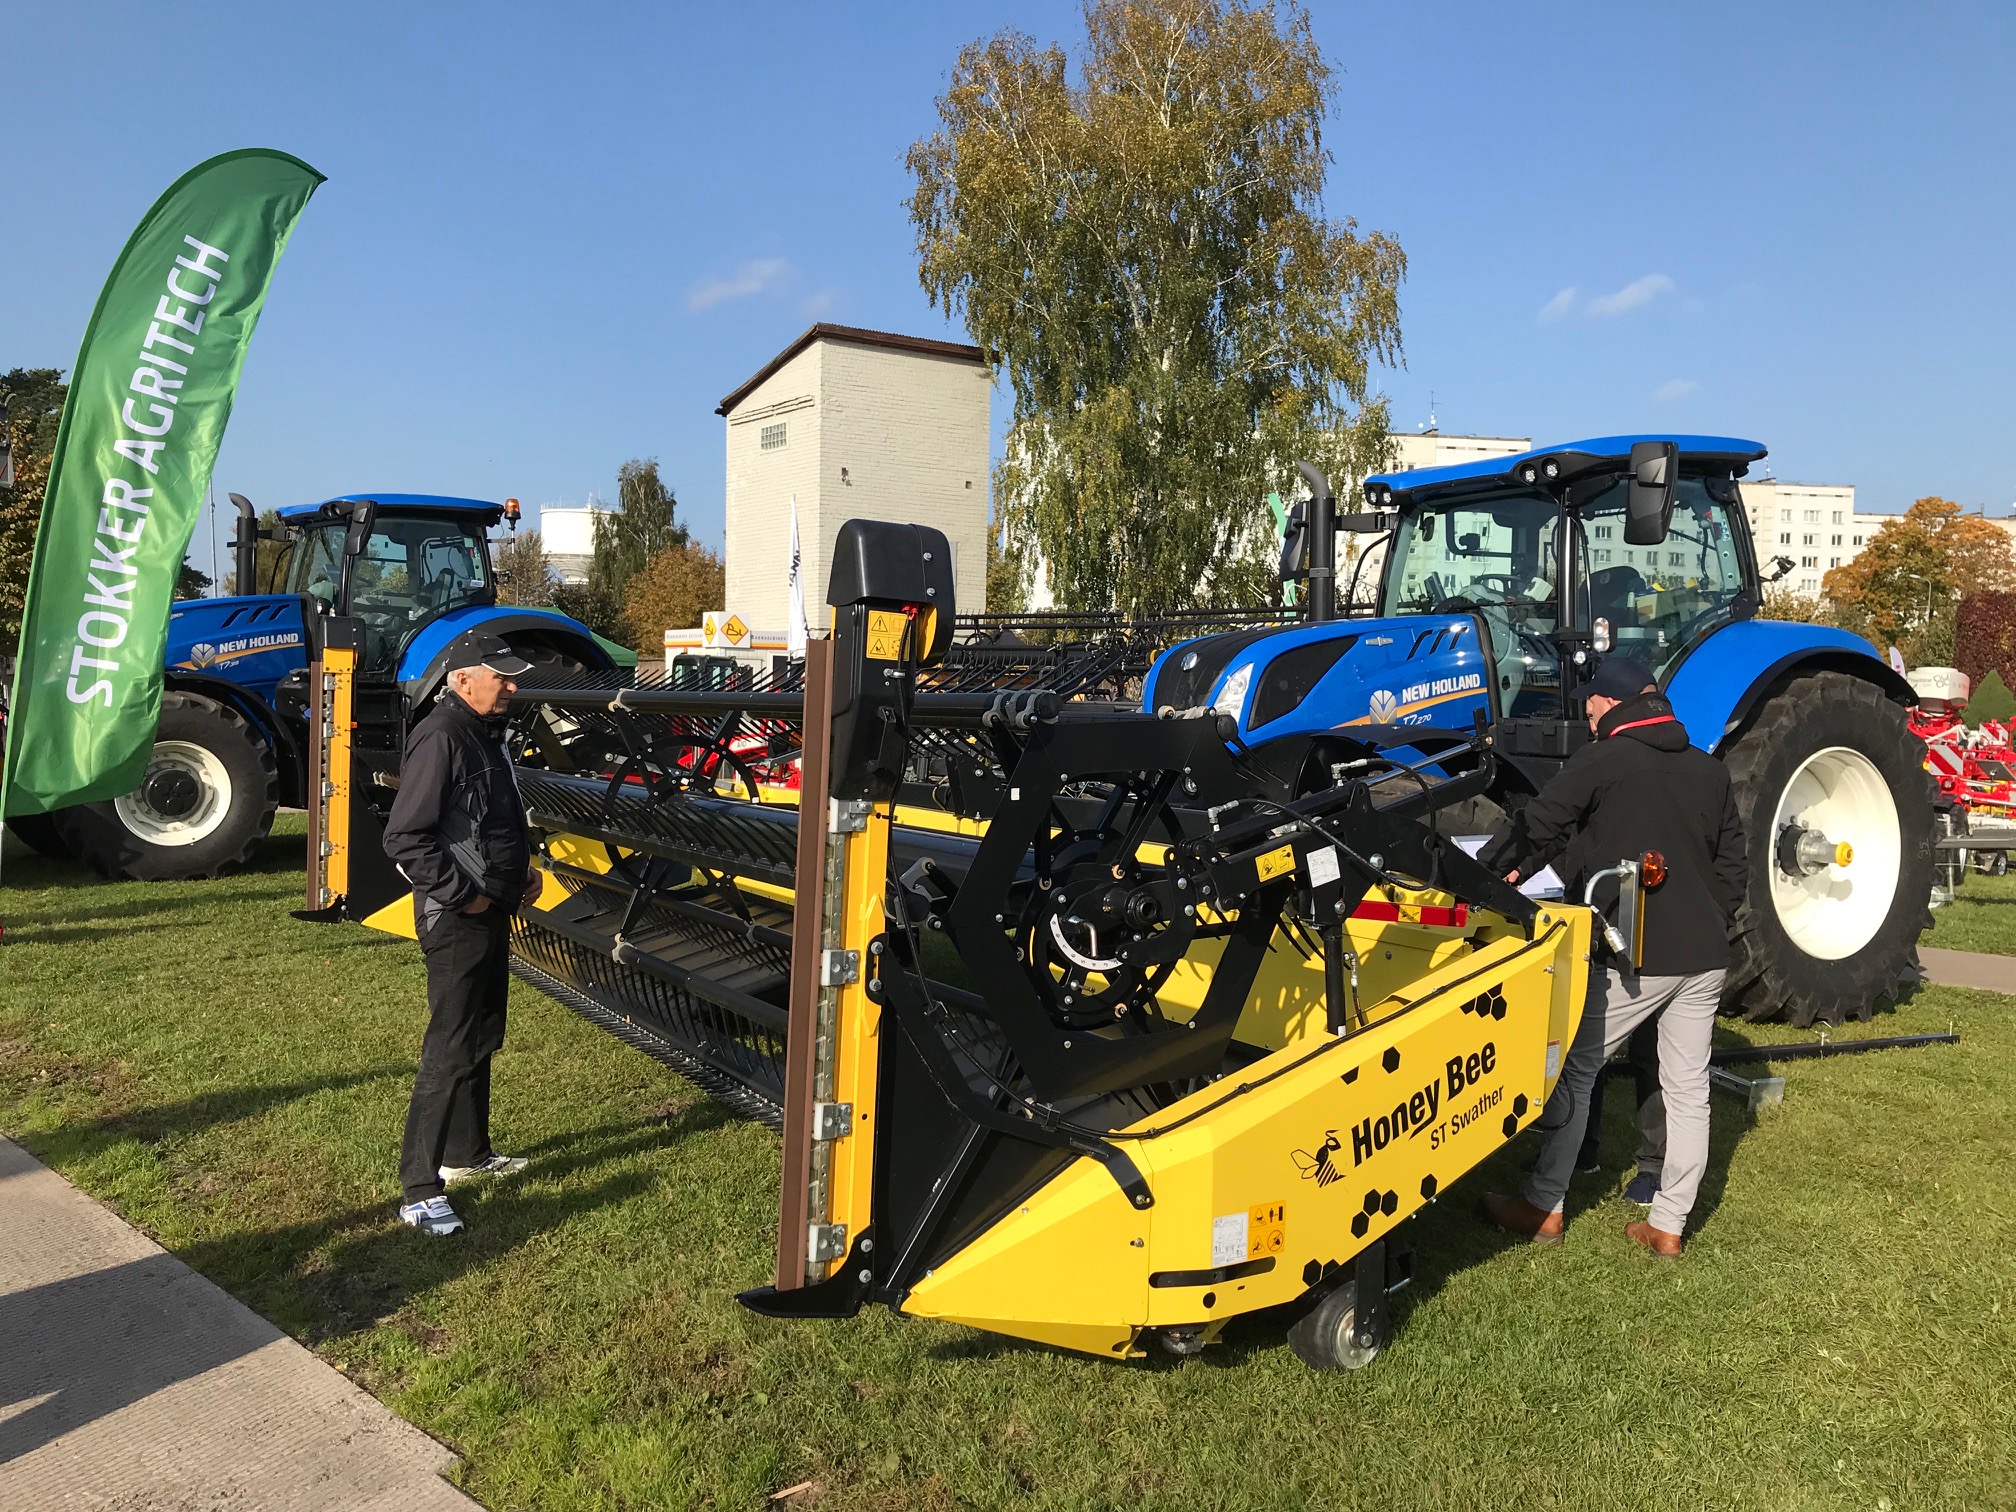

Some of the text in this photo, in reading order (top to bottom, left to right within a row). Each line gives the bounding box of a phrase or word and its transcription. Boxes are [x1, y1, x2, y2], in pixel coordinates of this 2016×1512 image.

[66, 234, 230, 708] STOKKER AGRITECH
[219, 632, 299, 654] NEW HOLLAND
[1402, 673, 1481, 704] NEW HOLLAND
[1350, 1077, 1441, 1168] Honey
[1445, 1041, 1497, 1103] Bee
[1430, 1085, 1505, 1151] ST Swather
